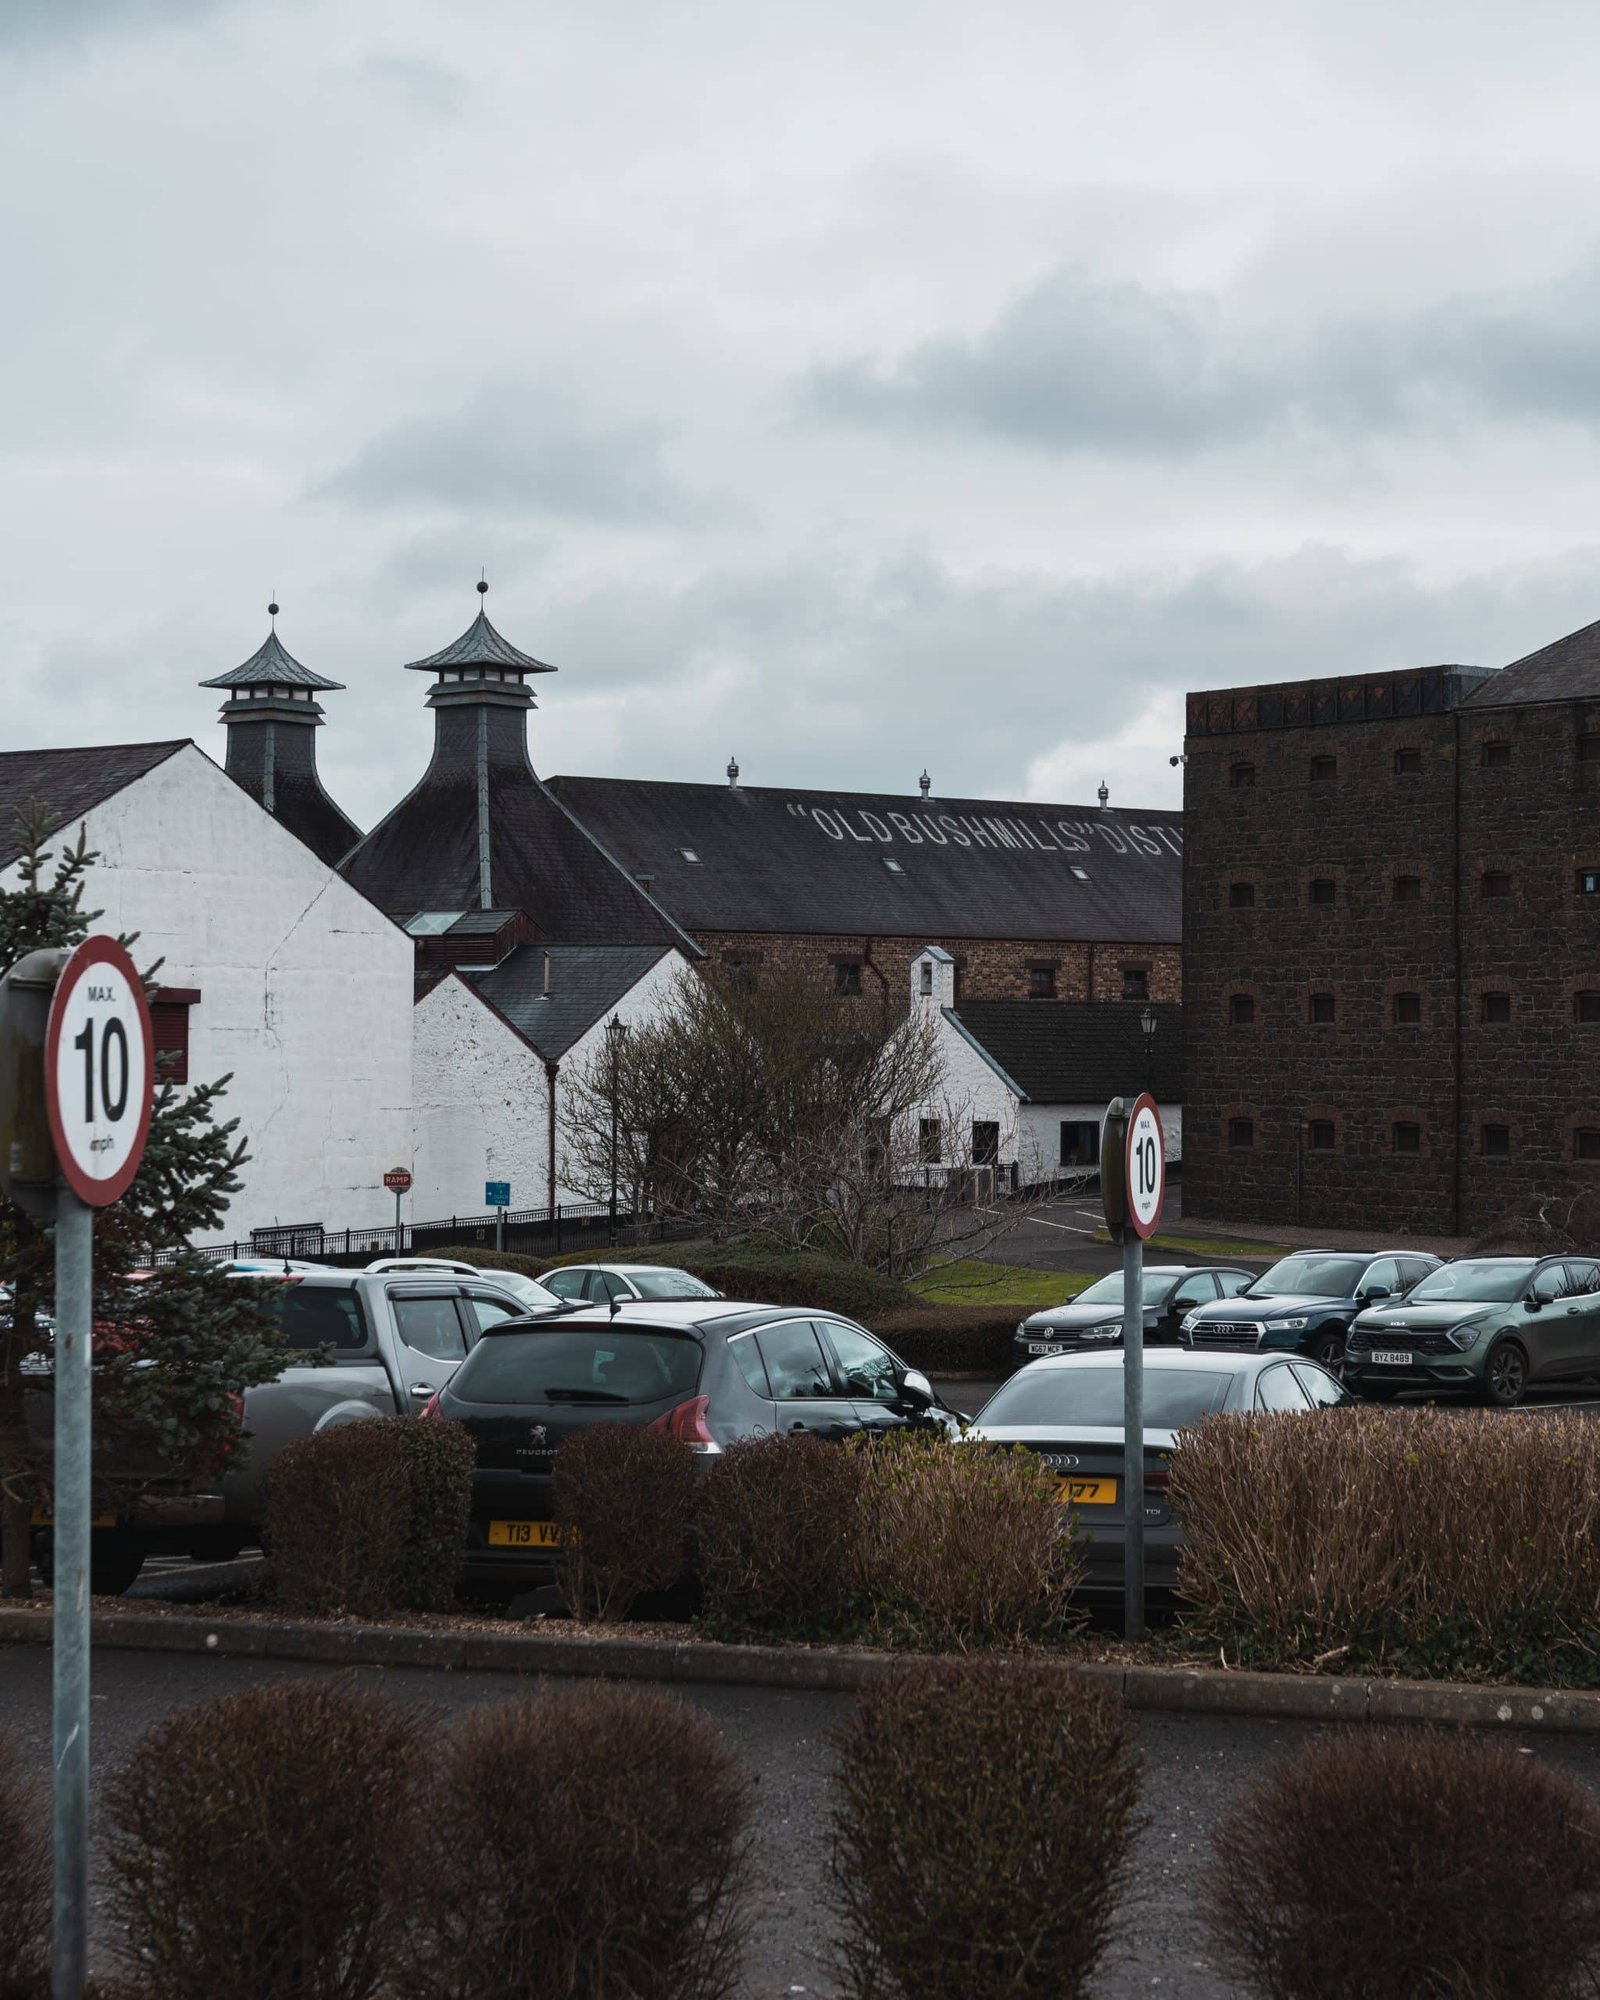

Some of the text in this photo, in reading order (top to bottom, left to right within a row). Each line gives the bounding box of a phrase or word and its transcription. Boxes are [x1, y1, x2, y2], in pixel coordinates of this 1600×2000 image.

[1092, 822, 1183, 856] DISTI
[74, 1017, 129, 1124] 10
[90, 1134, 114, 1155] mph
[1136, 1137, 1156, 1194] 10
[385, 1176, 409, 1185] RAMP
[516, 1448, 560, 1456] PEUGEOT
[507, 1524, 531, 1543] T13
